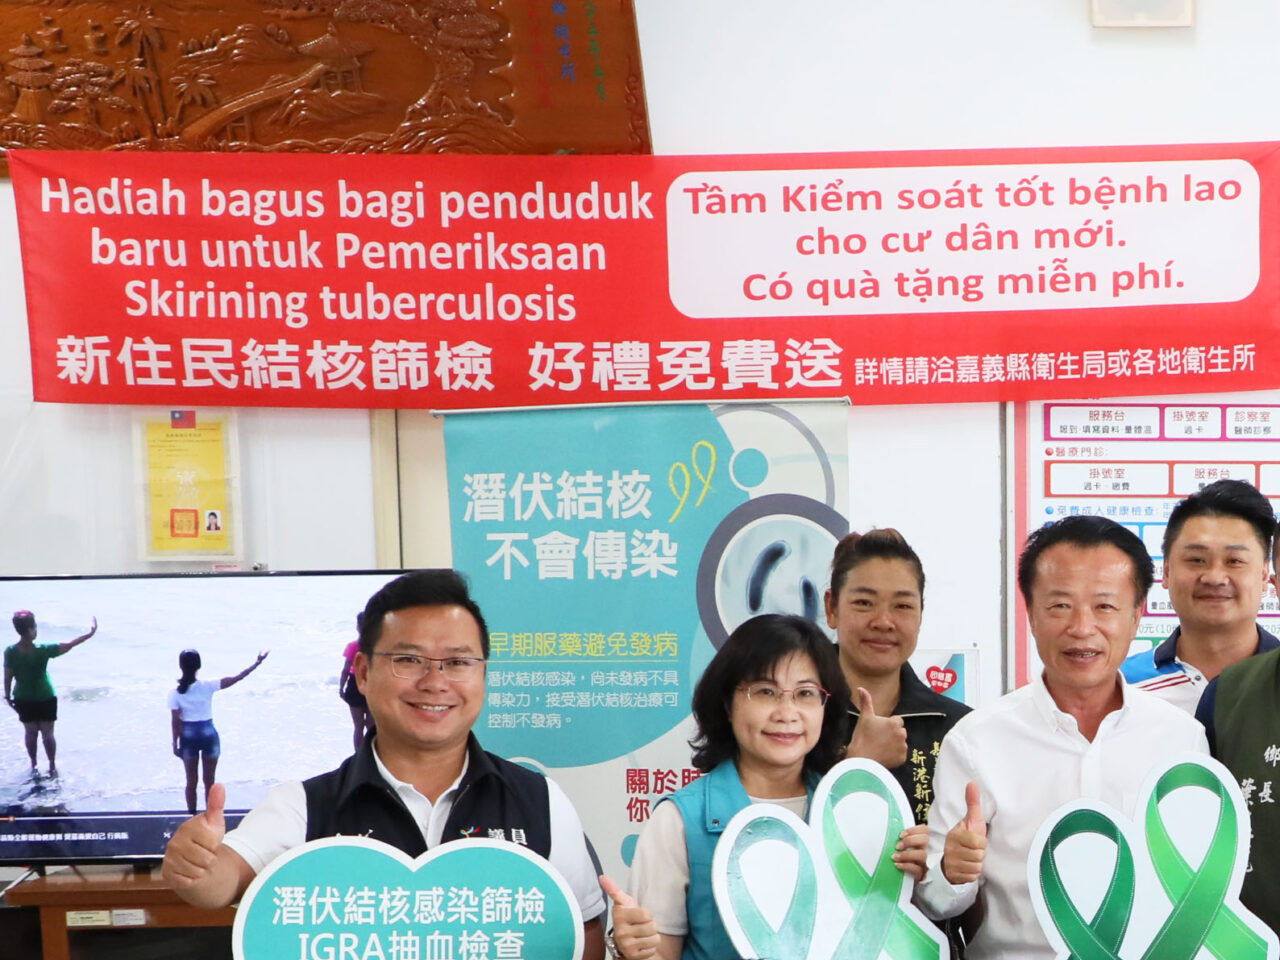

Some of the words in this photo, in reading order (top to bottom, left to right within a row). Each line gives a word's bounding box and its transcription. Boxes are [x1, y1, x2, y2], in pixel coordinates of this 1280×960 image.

[41, 177, 187, 217] Hadiah
[201, 179, 325, 226] bagus
[338, 181, 425, 226] bagi
[440, 181, 654, 227] penduduk
[683, 180, 768, 215] Tầm
[782, 171, 883, 213] Kiểm
[896, 178, 982, 210] soát
[995, 172, 1056, 208] tốt
[1067, 175, 1169, 206] bệnh
[1183, 173, 1243, 203] lao
[91, 228, 187, 267] baru
[200, 232, 323, 269] untuk
[336, 231, 607, 271] Pemeriksaan
[795, 226, 868, 257] cho
[881, 228, 932, 254] cư
[945, 221, 1020, 253] dân
[1034, 220, 1127, 250] mới.
[124, 280, 307, 327] Skirining
[319, 283, 577, 322] tuberculosis
[742, 271, 794, 301] Có
[806, 268, 881, 304] quà
[895, 268, 984, 304] tặng
[996, 258, 1097, 297] miễn
[1110, 260, 1186, 300] phí.
[56, 334, 495, 391] 新住民結核篩檢
[528, 337, 843, 391] 好禮免費送
[855, 343, 1256, 387] 詳情請洽嘉義縣衛生局或各地衛生所
[463, 470, 651, 522] 潛伏結核
[486, 530, 679, 580] 不會傳染
[489, 632, 679, 657] 早期服藥避免發病
[272, 886, 546, 926] 潛伏結核感染篩檢
